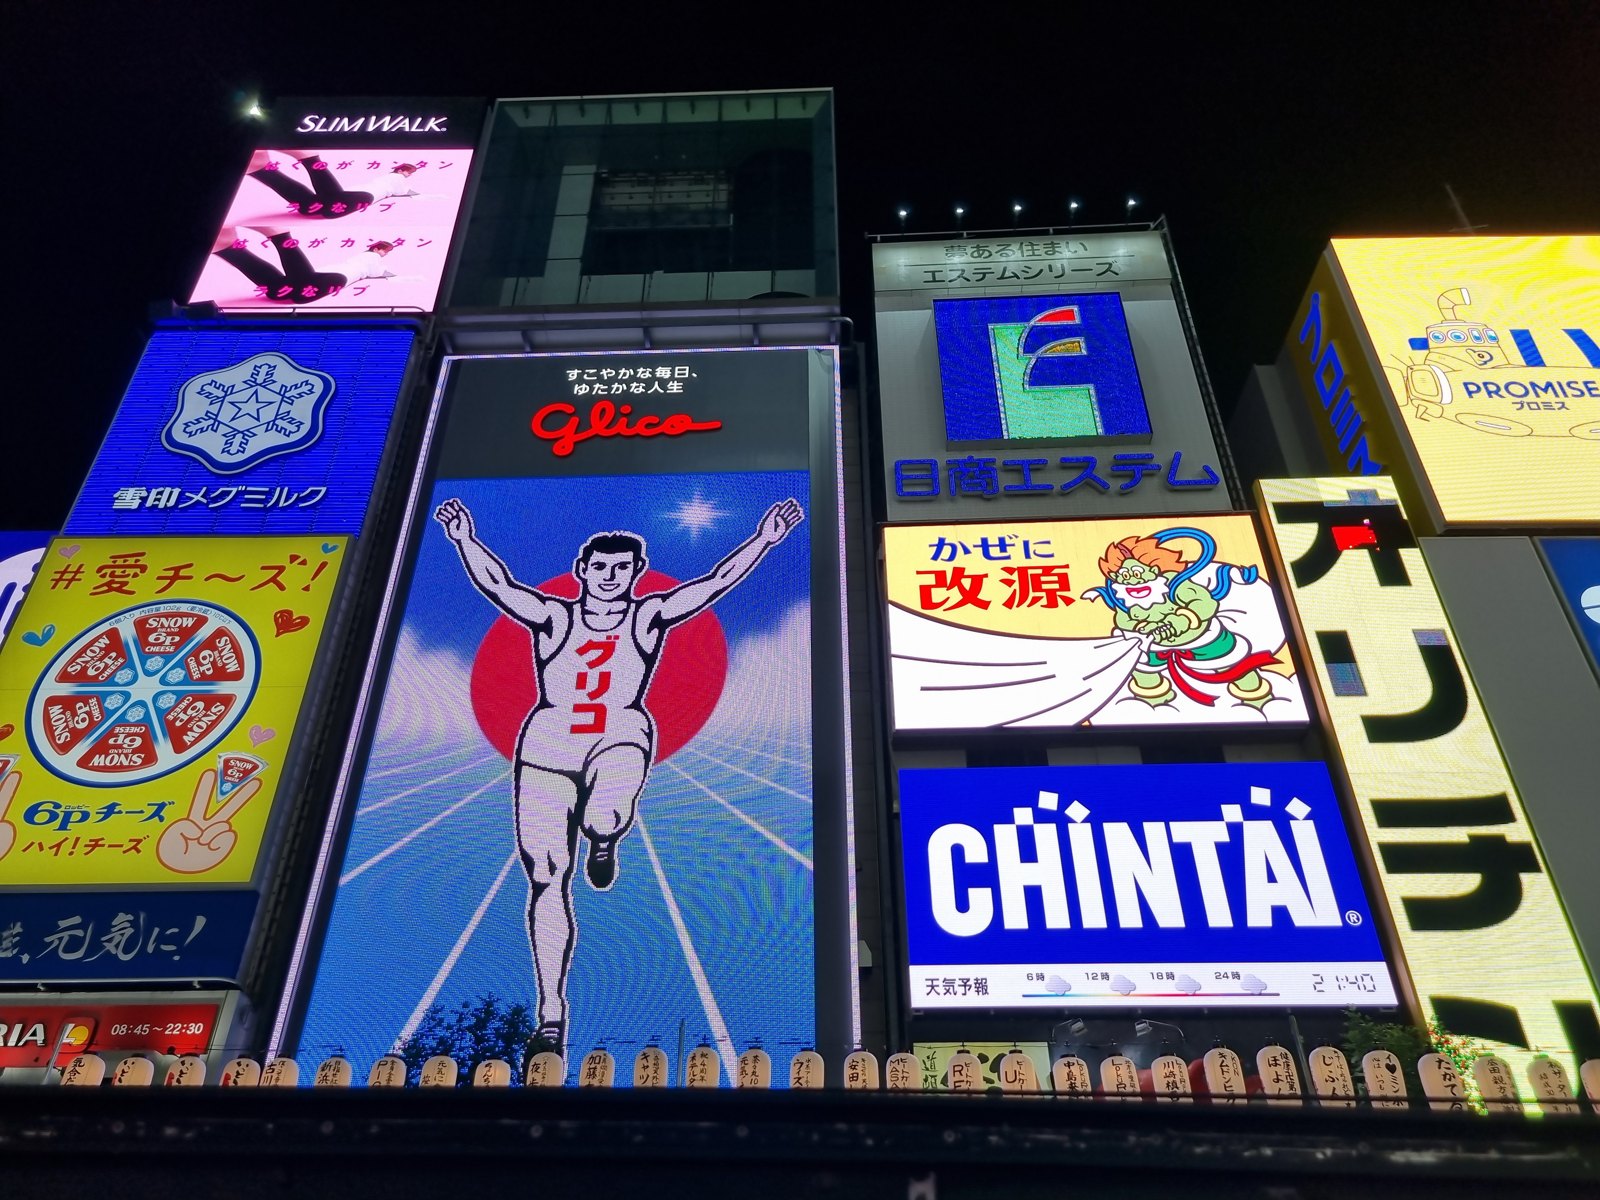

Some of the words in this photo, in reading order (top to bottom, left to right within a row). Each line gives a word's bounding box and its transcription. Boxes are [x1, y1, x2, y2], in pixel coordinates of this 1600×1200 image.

[943, 239, 1088, 260] 夢ある住まい
[922, 259, 1121, 284] エステムシリーズ
[573, 382, 684, 396] ゆたかな人生
[1462, 380, 1600, 399] PROMISE
[1511, 401, 1570, 411] プロミス
[894, 451, 1221, 498] 日商エステム
[112, 485, 327, 510] 雪印メグミルク
[928, 533, 1056, 562] かぜに
[915, 563, 1076, 612] 改源
[146, 617, 197, 628] SNOW
[67, 635, 111, 675] SNOW
[215, 636, 241, 673] SNOW
[570, 635, 620, 734] グリコ
[48, 704, 71, 744] SNOW
[182, 702, 226, 746] SNOW
[88, 753, 145, 767] SNOW
[228, 759, 254, 770] SNOW
[926, 786, 1344, 937] CHINTAI
[925, 976, 989, 997] 天気予報
[1026, 972, 1045, 982] 6時
[1084, 972, 1110, 981] 12時
[1150, 971, 1175, 981] 18時
[1214, 971, 1241, 981] 24時
[1311, 973, 1378, 994] 21:40
